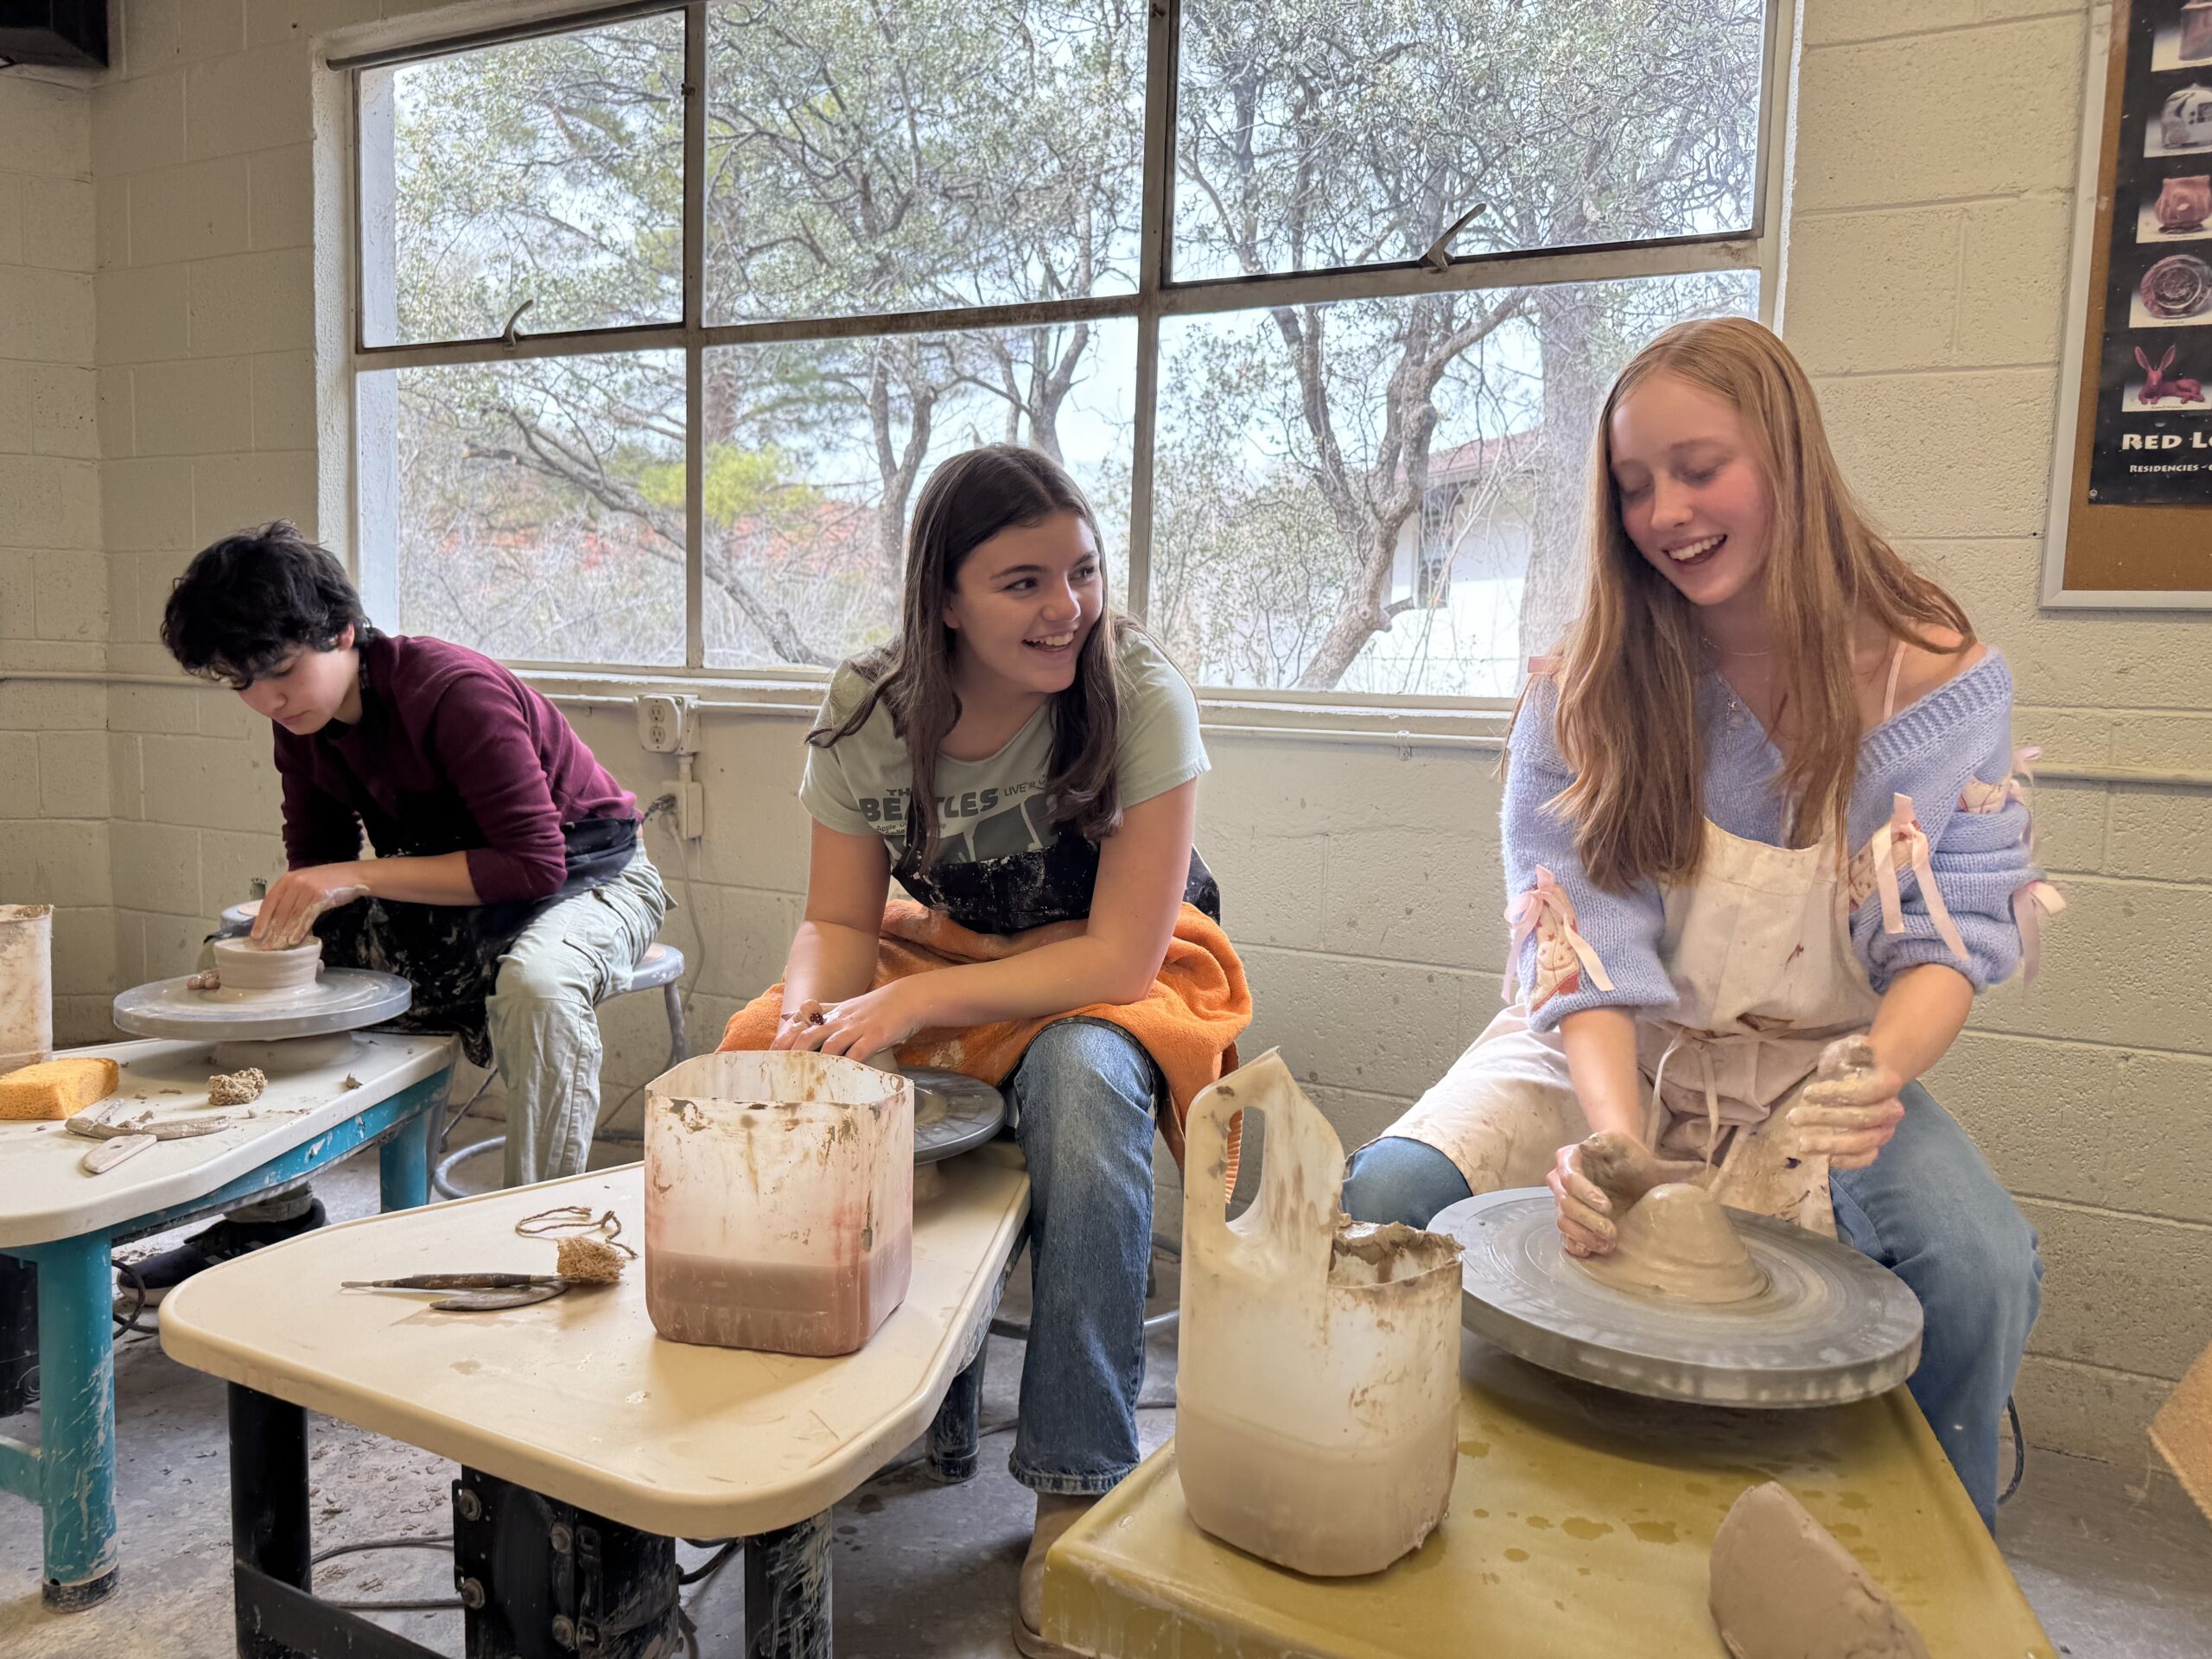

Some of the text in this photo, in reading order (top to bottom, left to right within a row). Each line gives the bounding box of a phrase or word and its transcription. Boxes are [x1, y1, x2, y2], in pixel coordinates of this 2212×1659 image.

[2122, 431, 2212, 449] RED L
[2129, 464, 2199, 473] RESIDENCIES
[886, 787, 912, 797] TH
[1004, 782, 1027, 797] LIVE
